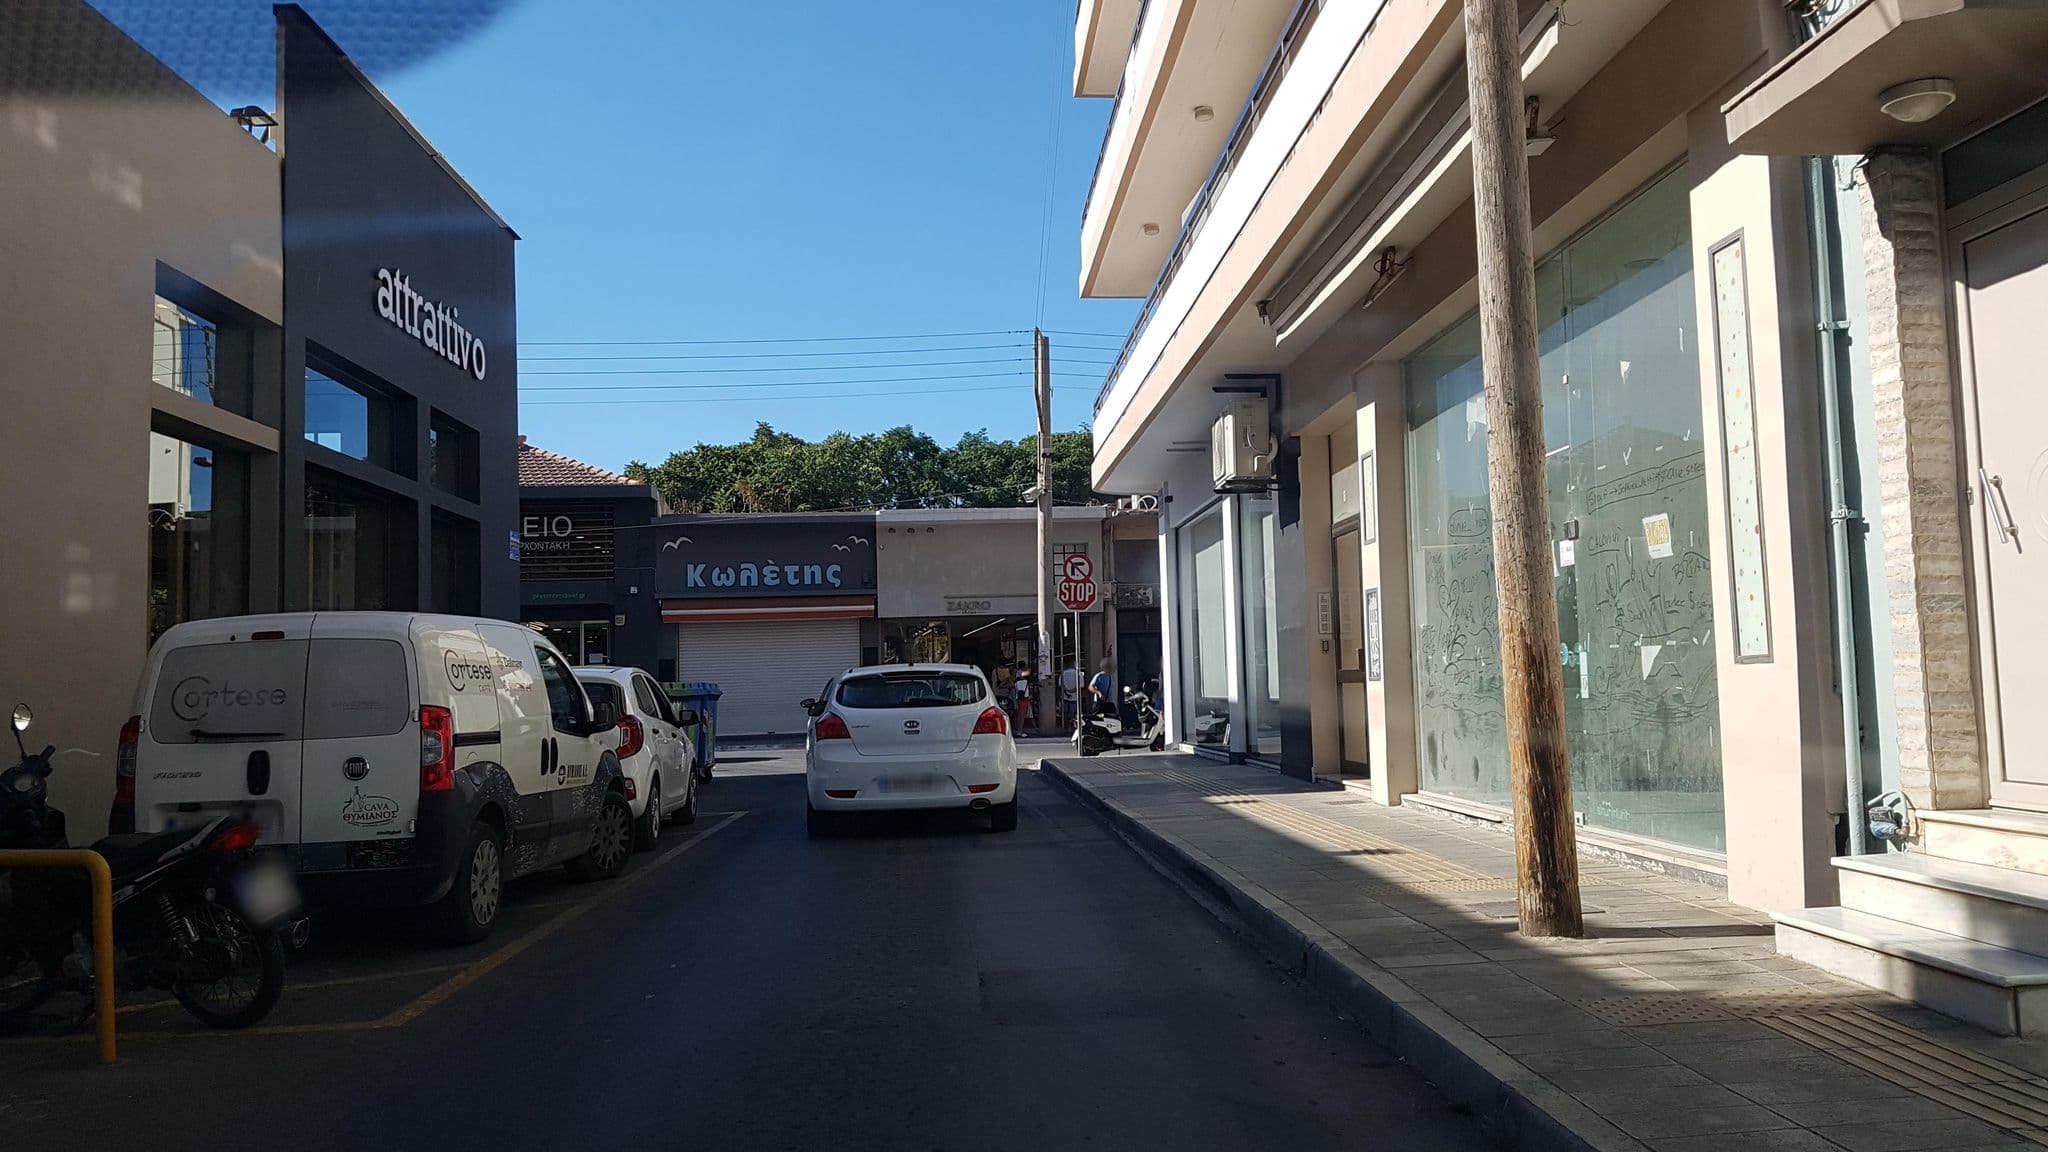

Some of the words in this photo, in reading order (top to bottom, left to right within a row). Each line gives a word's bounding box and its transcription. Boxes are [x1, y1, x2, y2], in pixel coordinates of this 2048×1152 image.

[378, 268, 486, 380] attrattivo
[1061, 582, 1094, 602] STOP
[444, 649, 491, 691] Cortese
[171, 676, 287, 721] Cortese
[343, 811, 398, 821] ΘΥΜΙΑΝΟΣ
[364, 803, 389, 811] CAVA
